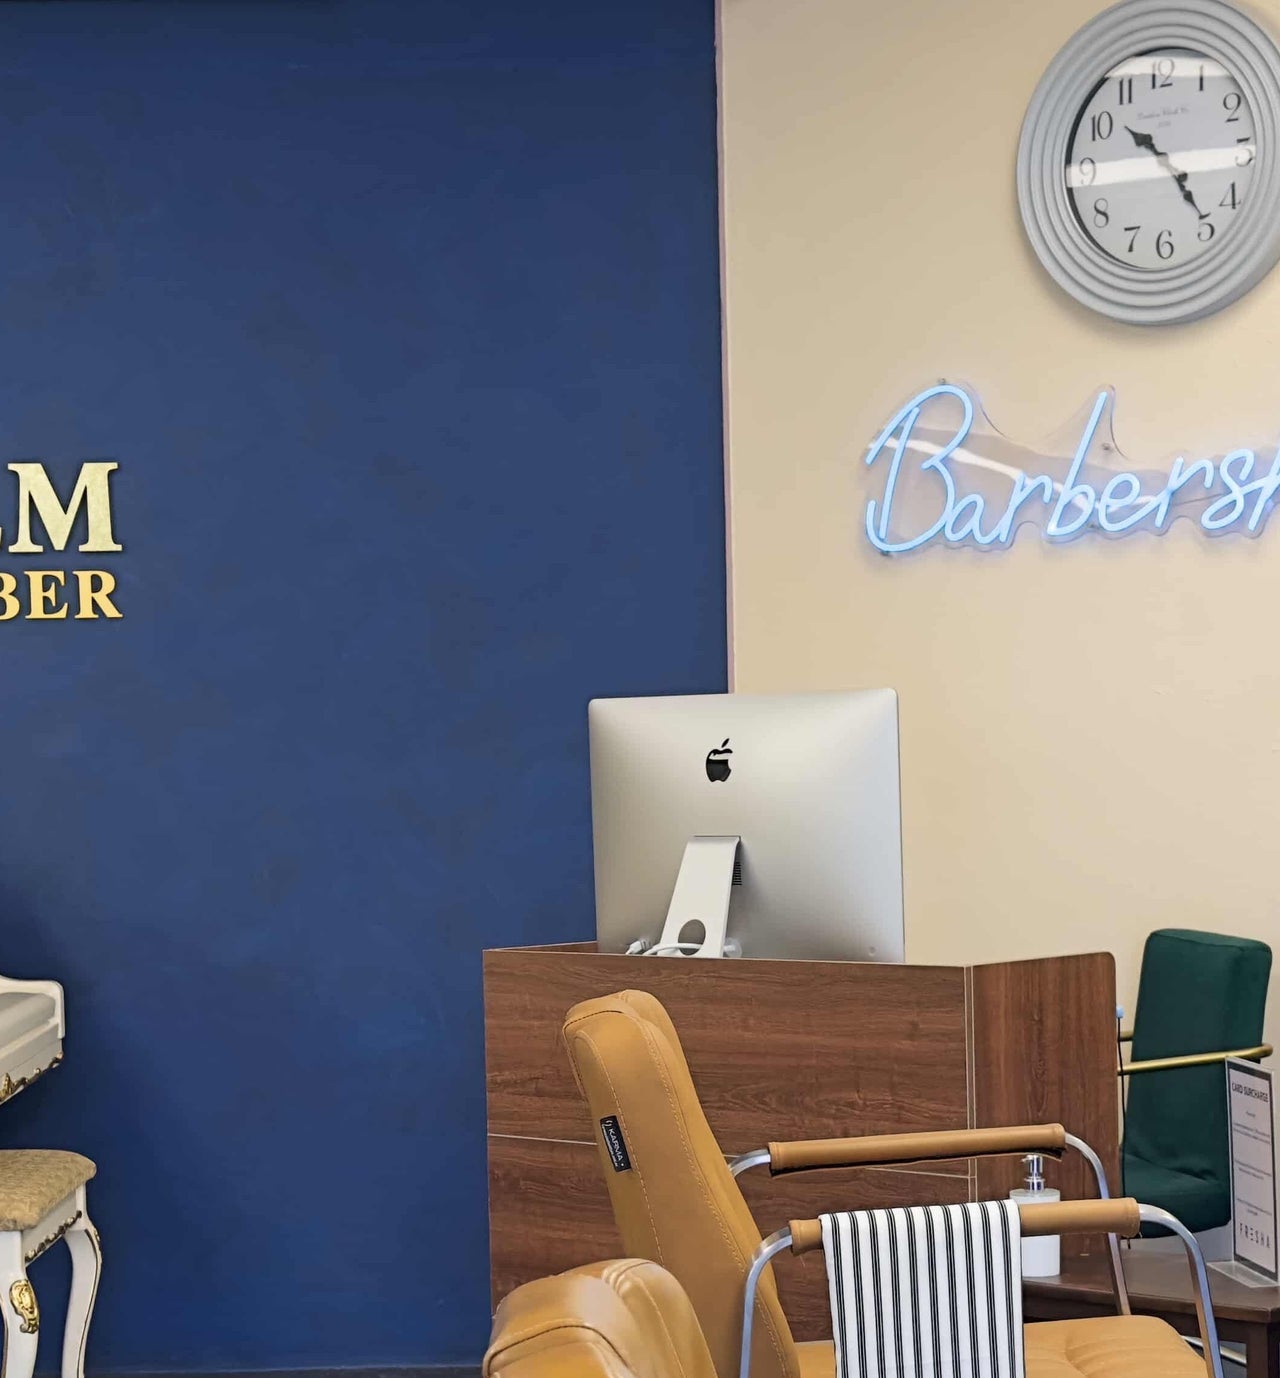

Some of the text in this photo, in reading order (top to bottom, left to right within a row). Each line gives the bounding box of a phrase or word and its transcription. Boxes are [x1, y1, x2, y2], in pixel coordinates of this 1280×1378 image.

[1150, 58, 1176, 90] 12
[1198, 63, 1205, 92] 1
[1118, 77, 1134, 106] 11
[1222, 92, 1242, 123] 2
[1090, 110, 1114, 142] 10
[1078, 156, 1097, 187] 9
[1218, 181, 1241, 210] 4
[1092, 197, 1110, 229] 8
[1196, 212, 1216, 243] 5
[1123, 225, 1142, 253] 7
[1155, 229, 1175, 260] 6
[608, 1128, 624, 1162] KARMA
